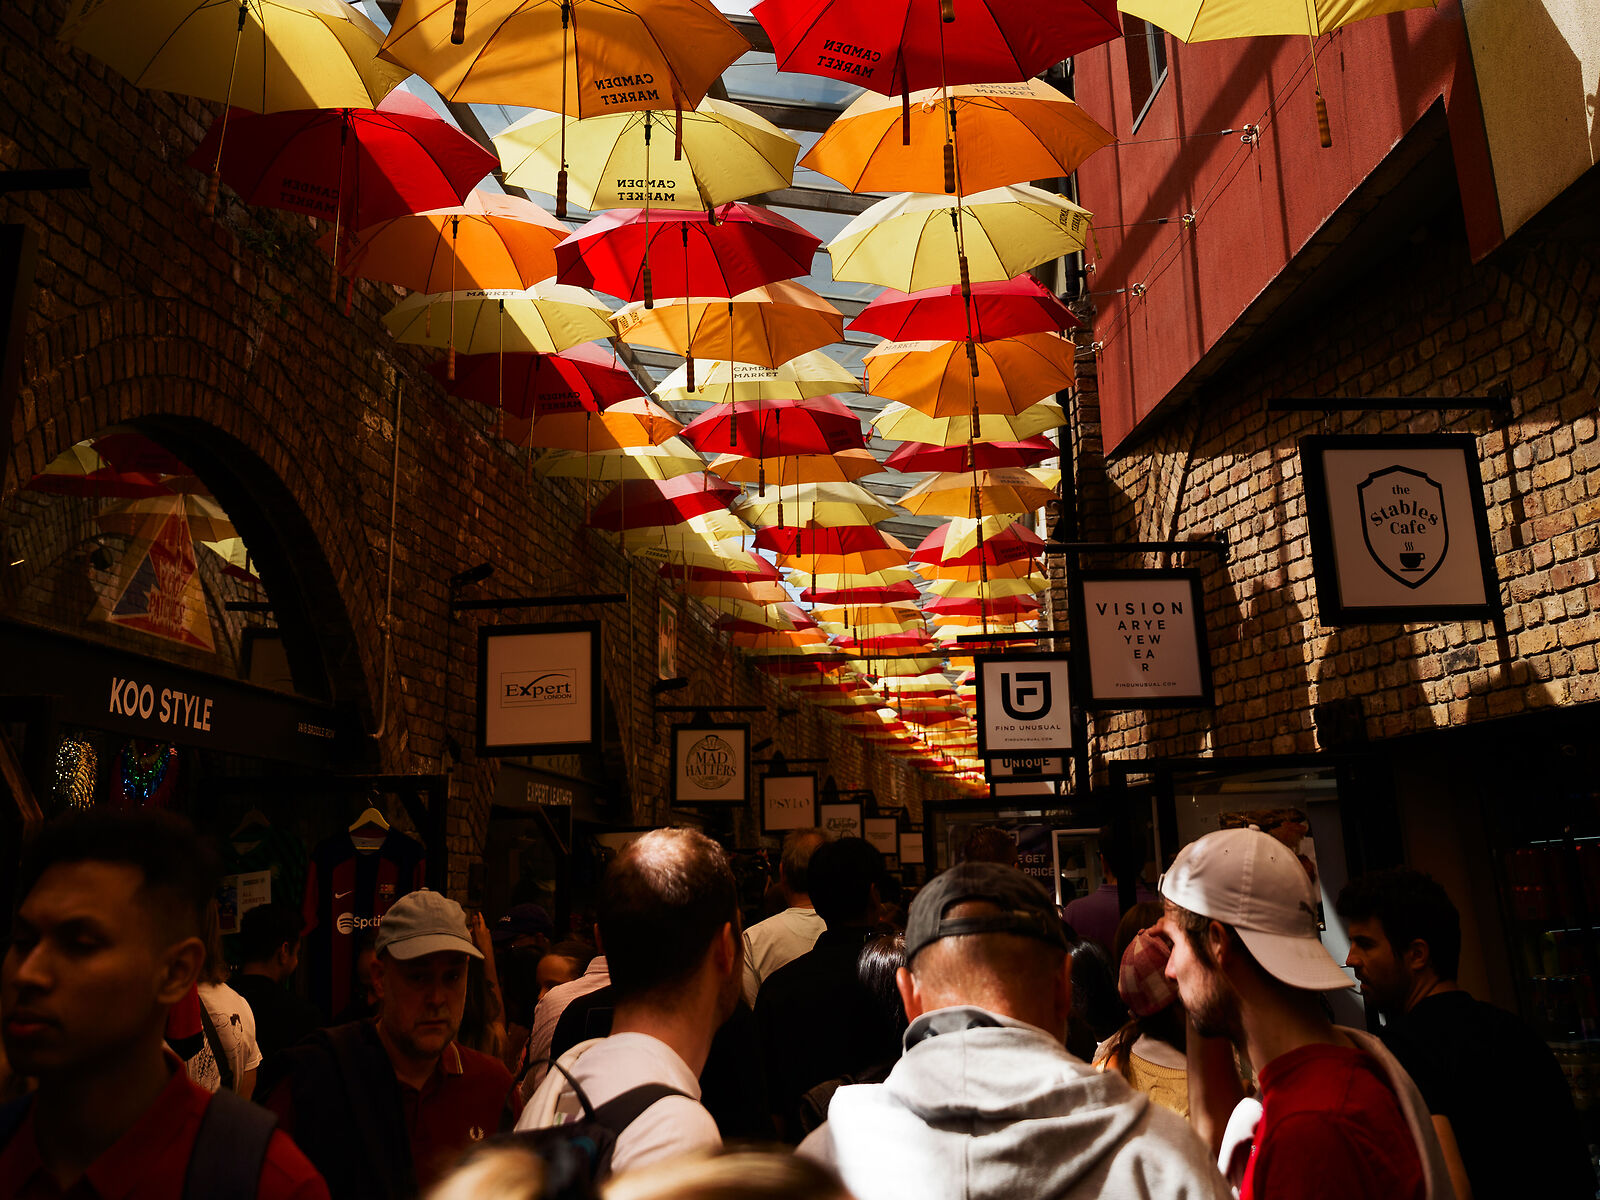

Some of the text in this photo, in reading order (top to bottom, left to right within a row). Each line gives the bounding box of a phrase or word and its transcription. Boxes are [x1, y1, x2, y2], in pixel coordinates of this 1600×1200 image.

[1391, 484, 1410, 495] the
[1370, 500, 1438, 527] Stables
[1390, 520, 1426, 535] Cafe
[1096, 602, 1183, 616] VISION
[1118, 620, 1165, 630] ARYE
[1124, 634, 1161, 644] YEW
[1134, 649, 1155, 659] EA
[1142, 663, 1149, 671] R
[505, 677, 571, 699] Expert
[109, 676, 214, 732] KOO STYLE
[696, 751, 728, 765] MAD
[1002, 757, 1051, 769] UNIQUE
[685, 764, 737, 777] HATTERS
[1025, 854, 1046, 863] GET
[1023, 866, 1055, 877] PRICE
[353, 914, 385, 930] Spotif
